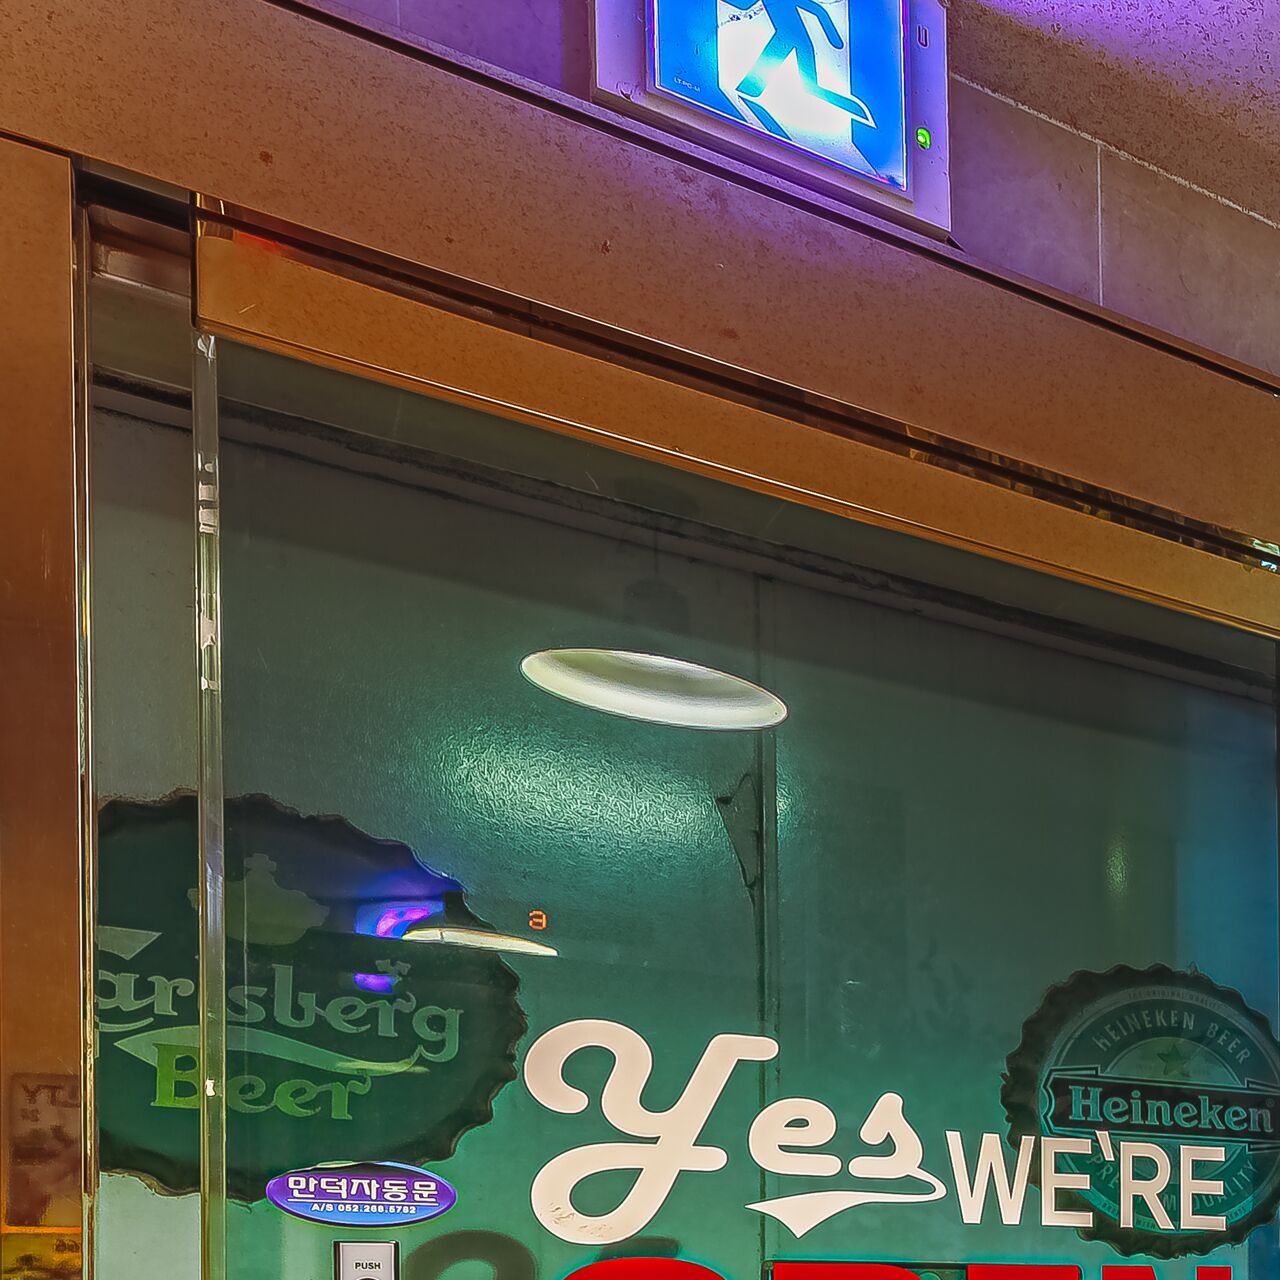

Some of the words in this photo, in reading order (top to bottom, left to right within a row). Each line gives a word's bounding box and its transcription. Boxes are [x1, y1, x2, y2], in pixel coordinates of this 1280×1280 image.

[1092, 1008, 1196, 1052] HEINEKEN
[1206, 1022, 1251, 1064] BEER
[523, 1018, 947, 1246] Yes
[1069, 1085, 1274, 1133] Heineken
[287, 1175, 439, 1202] 만덕자동문
[946, 1129, 1227, 1231] WE'RE
[354, 1261, 381, 1270] PUSH
